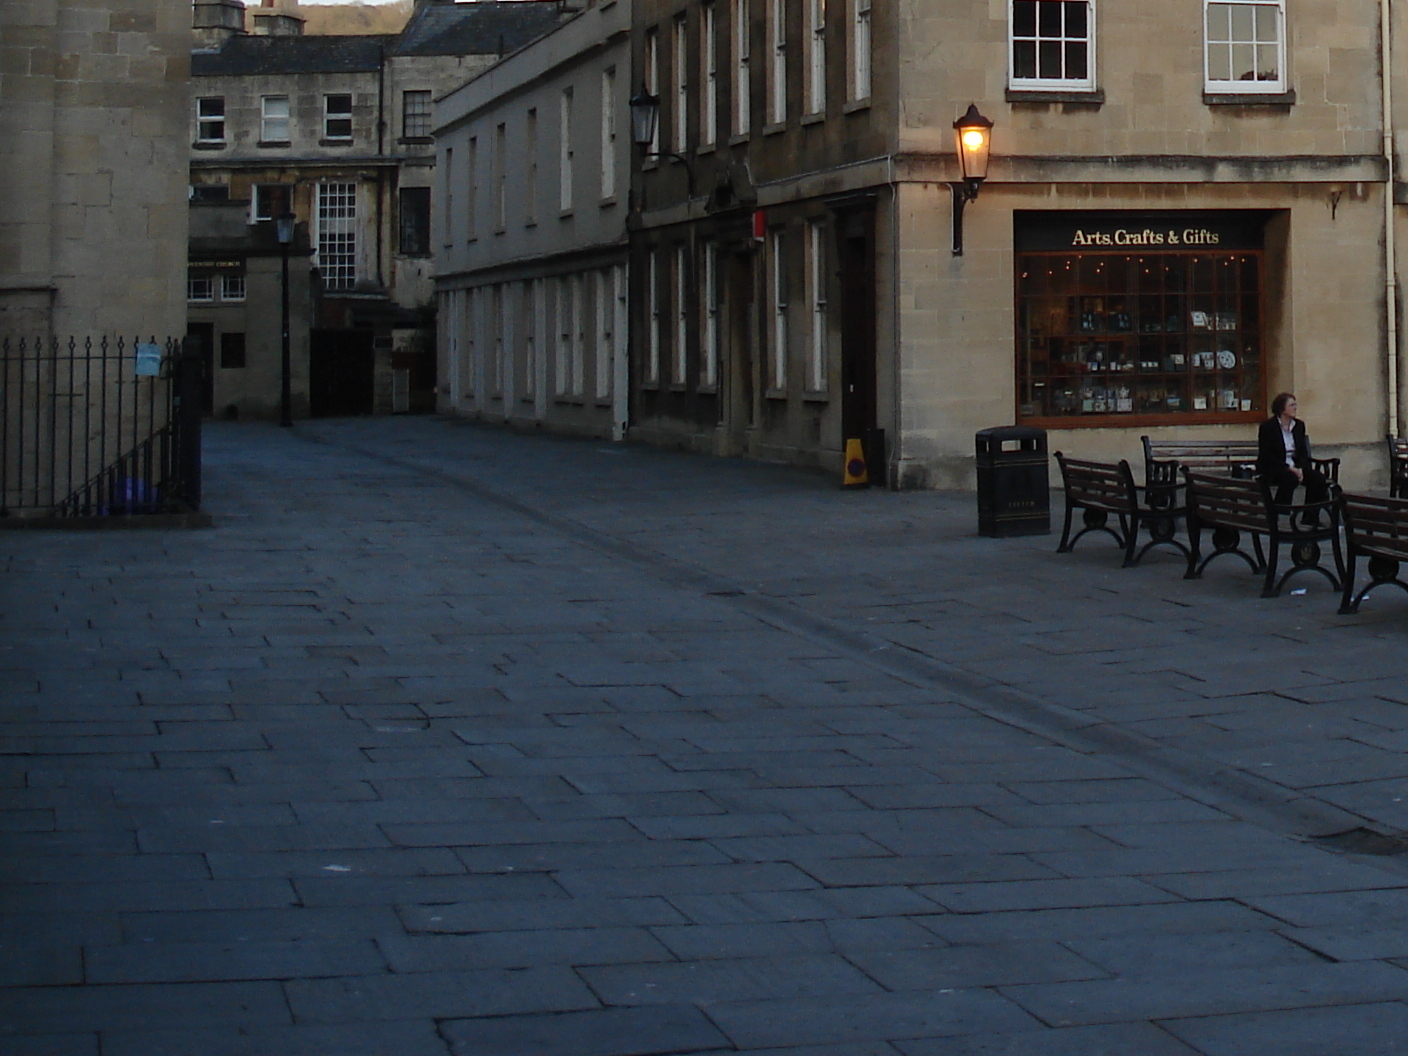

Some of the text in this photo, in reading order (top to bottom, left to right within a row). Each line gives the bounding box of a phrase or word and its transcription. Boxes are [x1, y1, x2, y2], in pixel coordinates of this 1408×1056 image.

[1114, 228, 1164, 245] Crafts
[1167, 230, 1180, 245] &
[1183, 228, 1219, 244] Gifts
